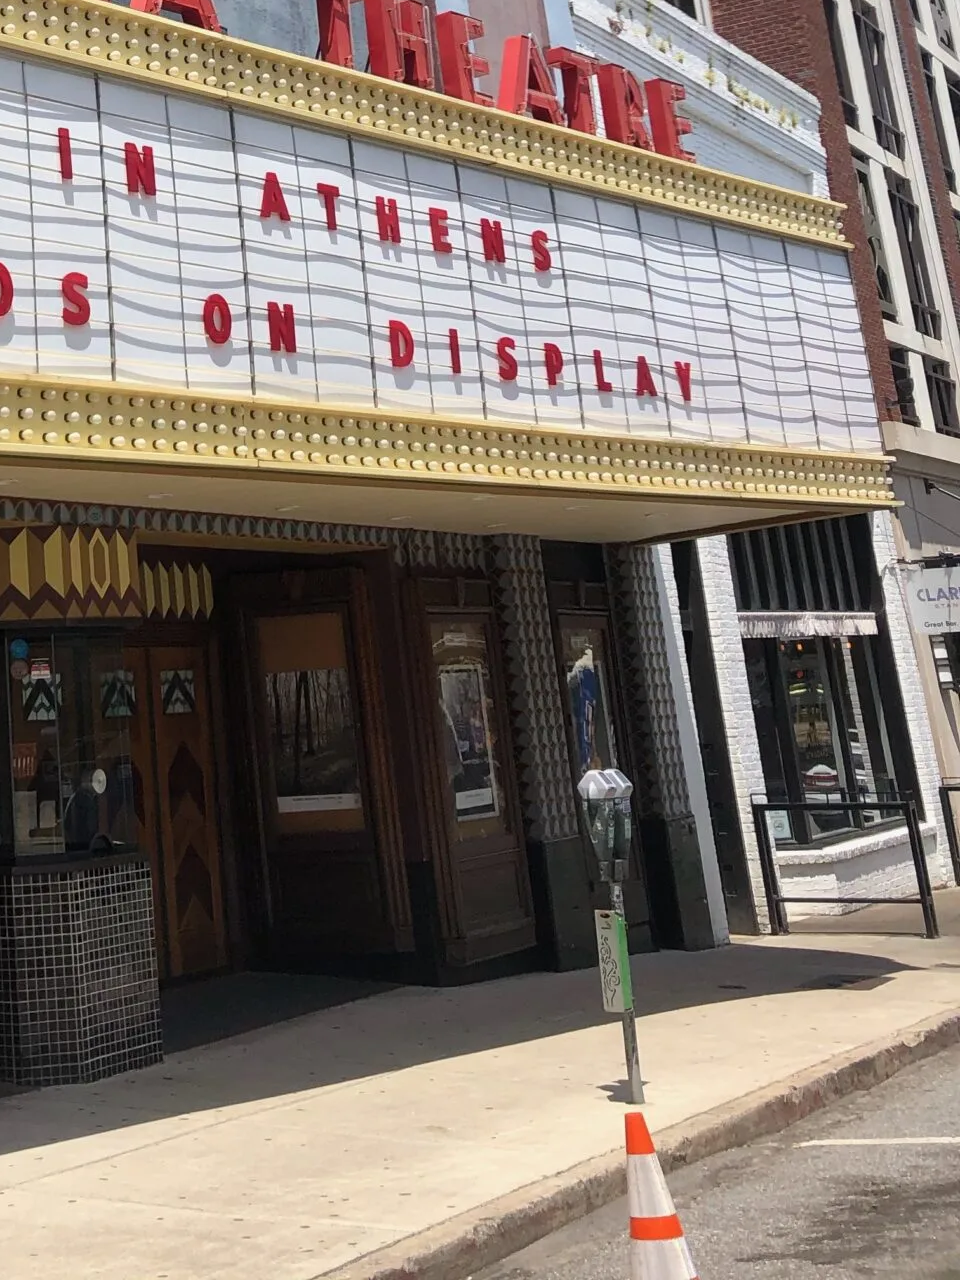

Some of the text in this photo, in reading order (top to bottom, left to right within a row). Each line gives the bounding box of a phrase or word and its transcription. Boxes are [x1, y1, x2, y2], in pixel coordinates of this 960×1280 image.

[56, 127, 157, 197] IN
[259, 171, 552, 273] ATHENS
[201, 293, 298, 353] ON
[387, 319, 692, 402] DISPLAY
